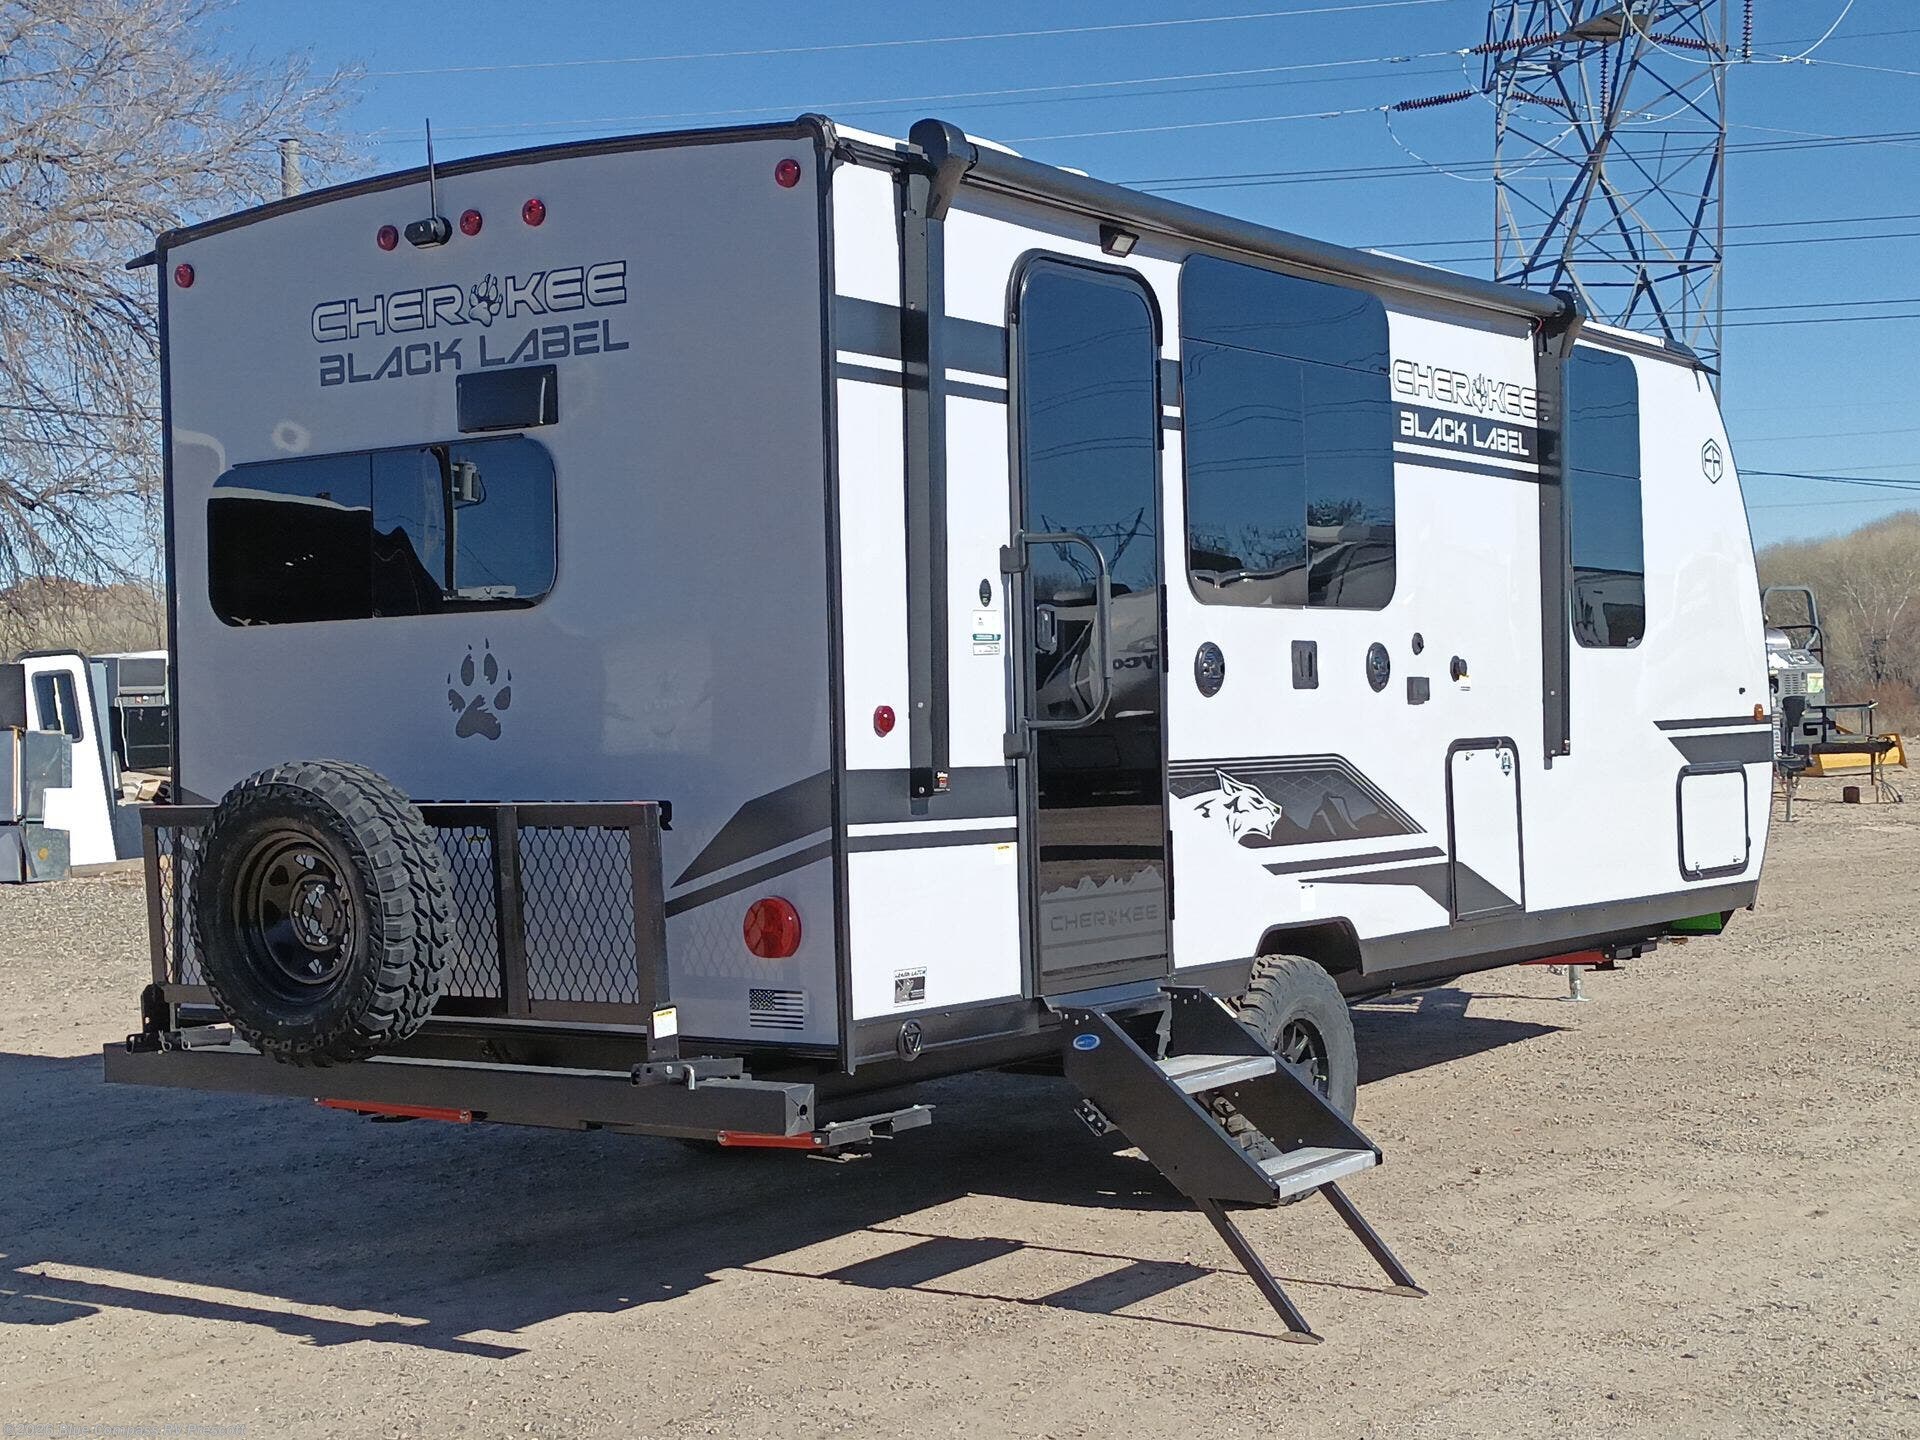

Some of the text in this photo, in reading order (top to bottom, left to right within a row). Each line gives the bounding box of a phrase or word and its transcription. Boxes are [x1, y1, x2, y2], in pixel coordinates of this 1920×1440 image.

[320, 319, 630, 387] BLACK LABEL
[1400, 411, 1530, 456] BLACK LABEL
